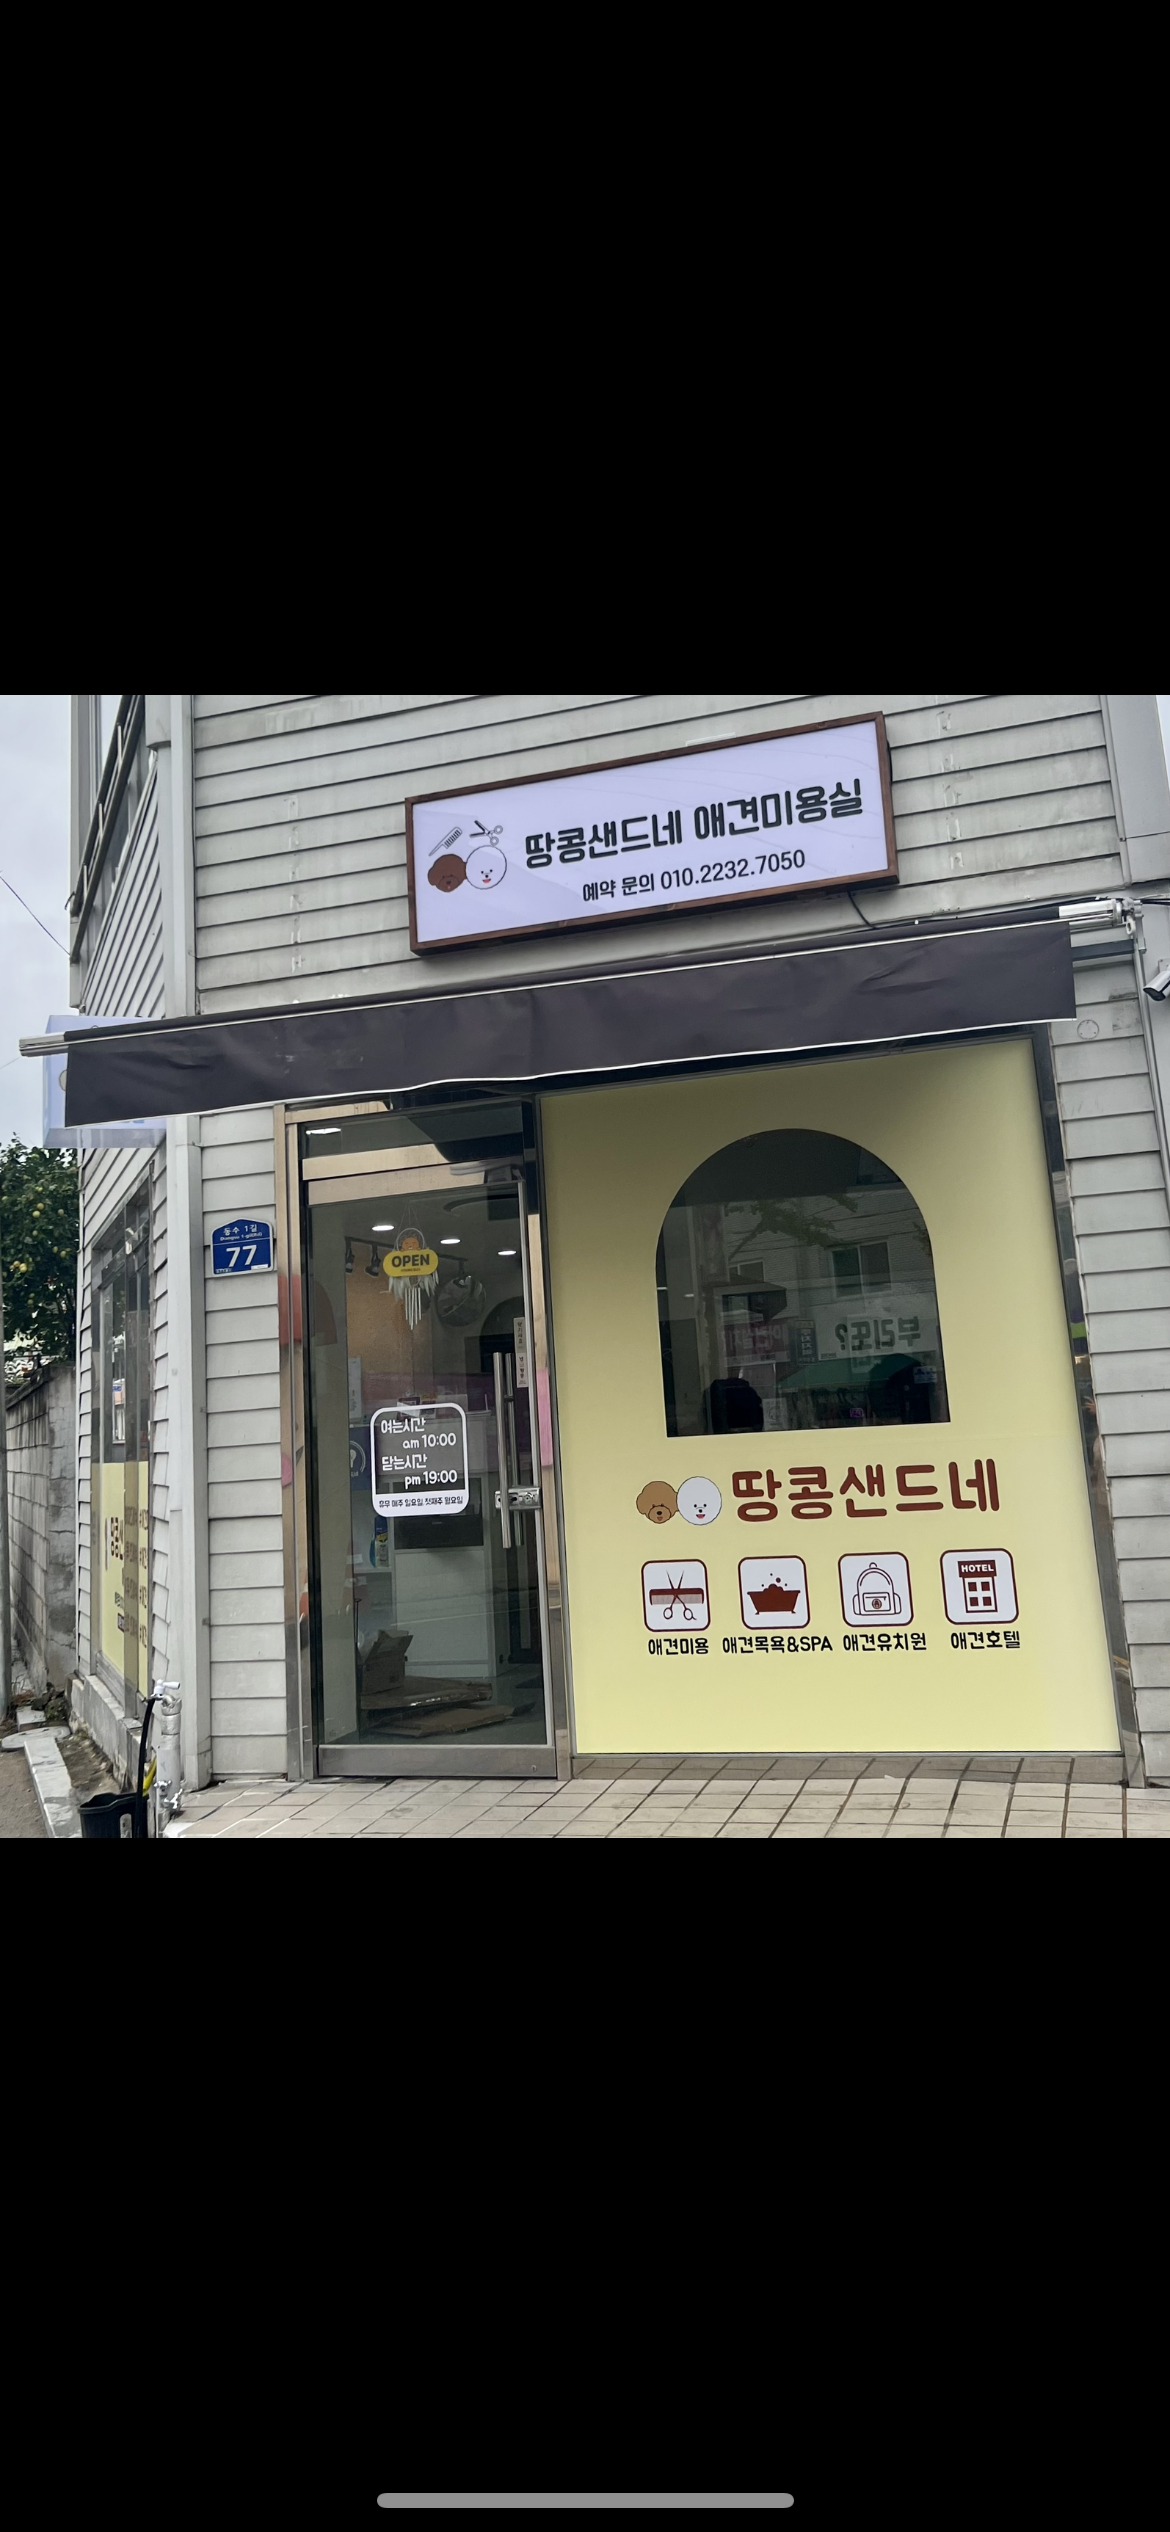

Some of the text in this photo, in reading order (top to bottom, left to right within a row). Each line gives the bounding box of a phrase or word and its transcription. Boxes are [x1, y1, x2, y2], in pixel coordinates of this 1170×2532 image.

[525, 778, 864, 870] 땅콩샌드네 애견미용실
[582, 849, 806, 903] 예약 문의 010.2232.7050
[223, 1224, 258, 1236] 동수 1길
[226, 1244, 258, 1268] 77
[391, 1253, 430, 1268] OPEN
[380, 1417, 426, 1434] 여는시간
[402, 1432, 457, 1449] am 10:00
[381, 1453, 428, 1471] 닫는시간
[404, 1469, 458, 1490] pm 19:00
[731, 1457, 1001, 1524] 땅콩샌드네
[378, 1500, 391, 1508] 휴무
[391, 1499, 404, 1508] 매주
[424, 1496, 443, 1506] 첫째주
[444, 1495, 464, 1505] 월요일
[960, 1563, 995, 1574] HOTEL
[647, 1637, 709, 1656] 애견미용
[722, 1634, 834, 1655] 애견목욕&SPA
[842, 1632, 928, 1652] 애견유치원
[950, 1630, 1021, 1650] 애견호텔
